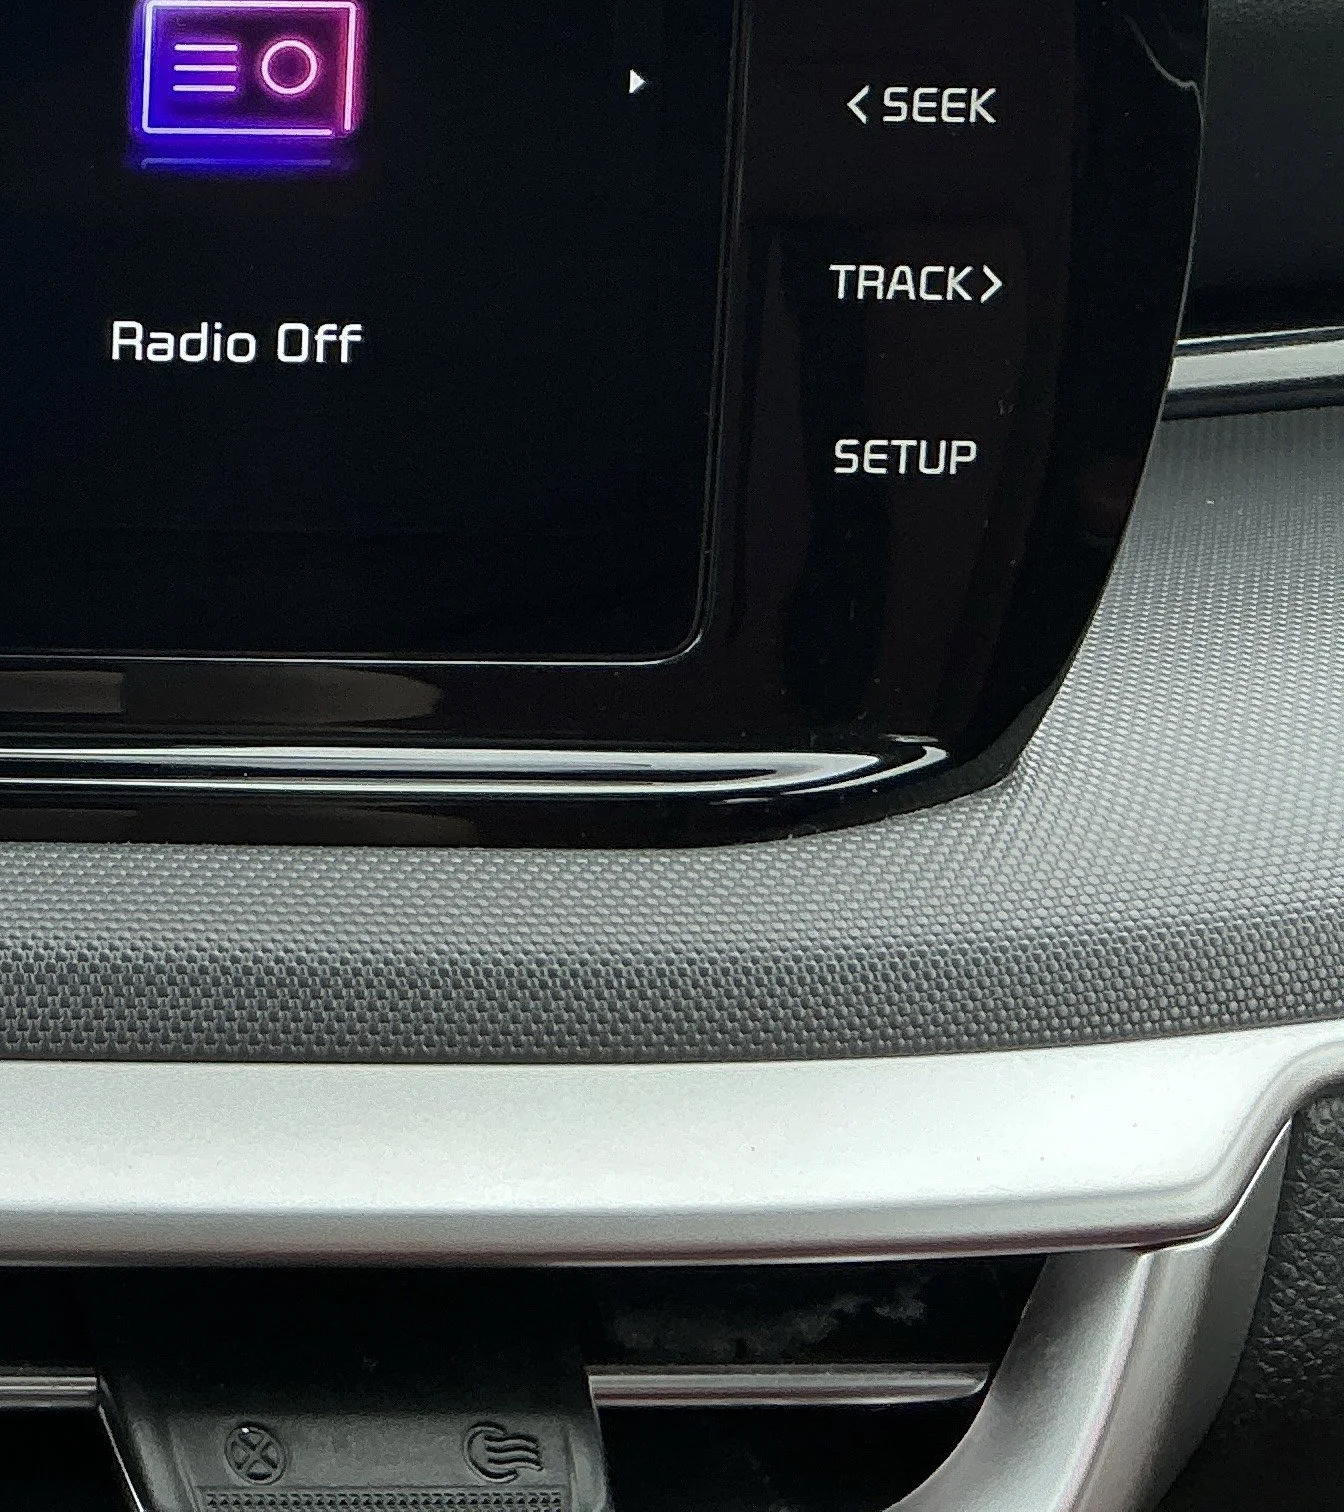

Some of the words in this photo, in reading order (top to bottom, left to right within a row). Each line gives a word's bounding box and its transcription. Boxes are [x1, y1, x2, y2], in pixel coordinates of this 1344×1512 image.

[883, 86, 998, 124] SEEK
[828, 264, 974, 302] TRACK
[111, 320, 258, 363] Radio
[276, 320, 364, 364] Off
[833, 438, 978, 475] SETUP
